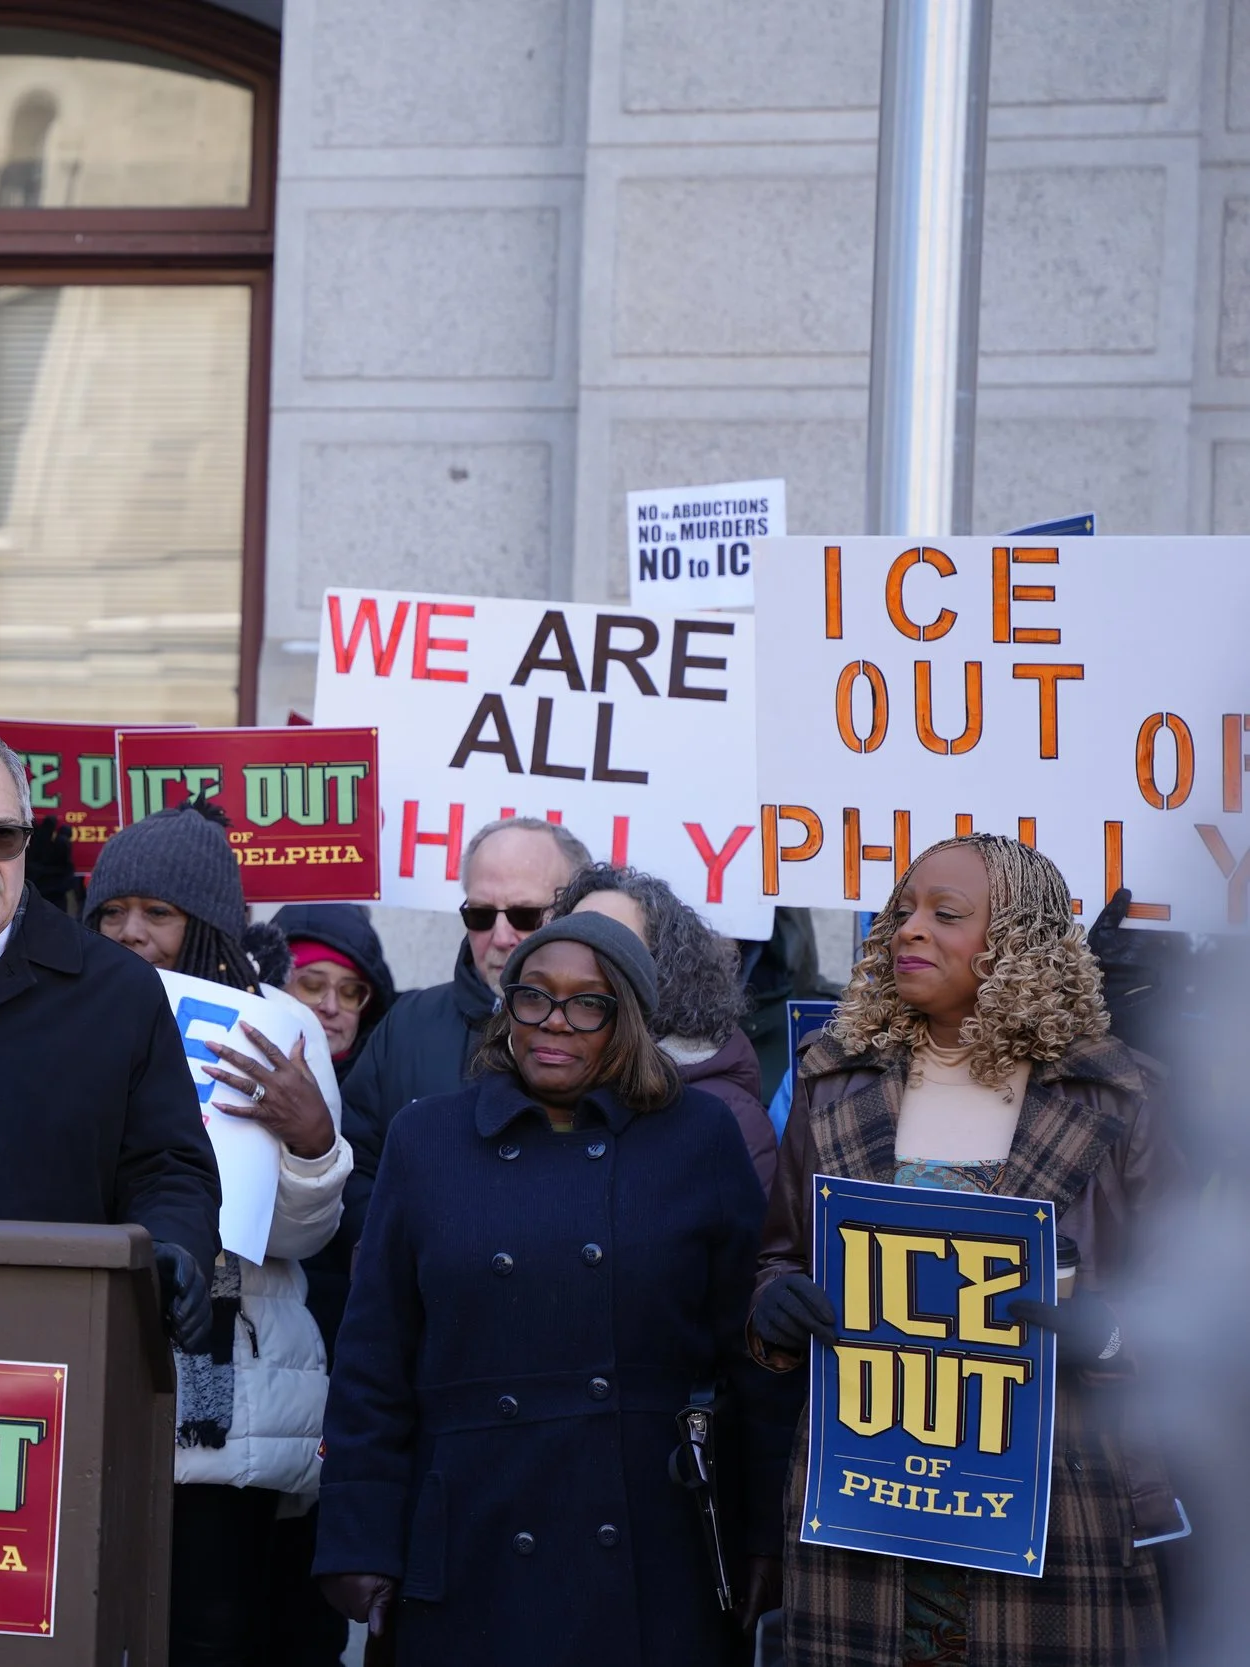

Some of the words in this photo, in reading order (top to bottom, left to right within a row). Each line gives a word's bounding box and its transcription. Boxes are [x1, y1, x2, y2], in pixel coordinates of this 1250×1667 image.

[638, 505, 658, 521] NO
[672, 498, 768, 519] ABDUCTIONS
[638, 525, 661, 543] NO
[666, 531, 676, 541] to
[680, 518, 768, 541] MURDERS
[639, 547, 681, 581] NO
[688, 558, 709, 578] to
[717, 542, 750, 577] IC
[824, 546, 1061, 644] ICE
[327, 595, 475, 683] WE
[510, 610, 735, 701] ARE
[835, 660, 1084, 759] OUT
[449, 693, 649, 784] ALL
[65, 812, 87, 823] OF
[242, 762, 368, 827] OUT
[229, 832, 254, 844] OF
[231, 846, 363, 866] DELPHIA
[838, 1220, 1029, 1348] ICE
[832, 1338, 1034, 1455] OUT
[905, 1455, 951, 1478] OF
[838, 1470, 1014, 1518] PHILLY
